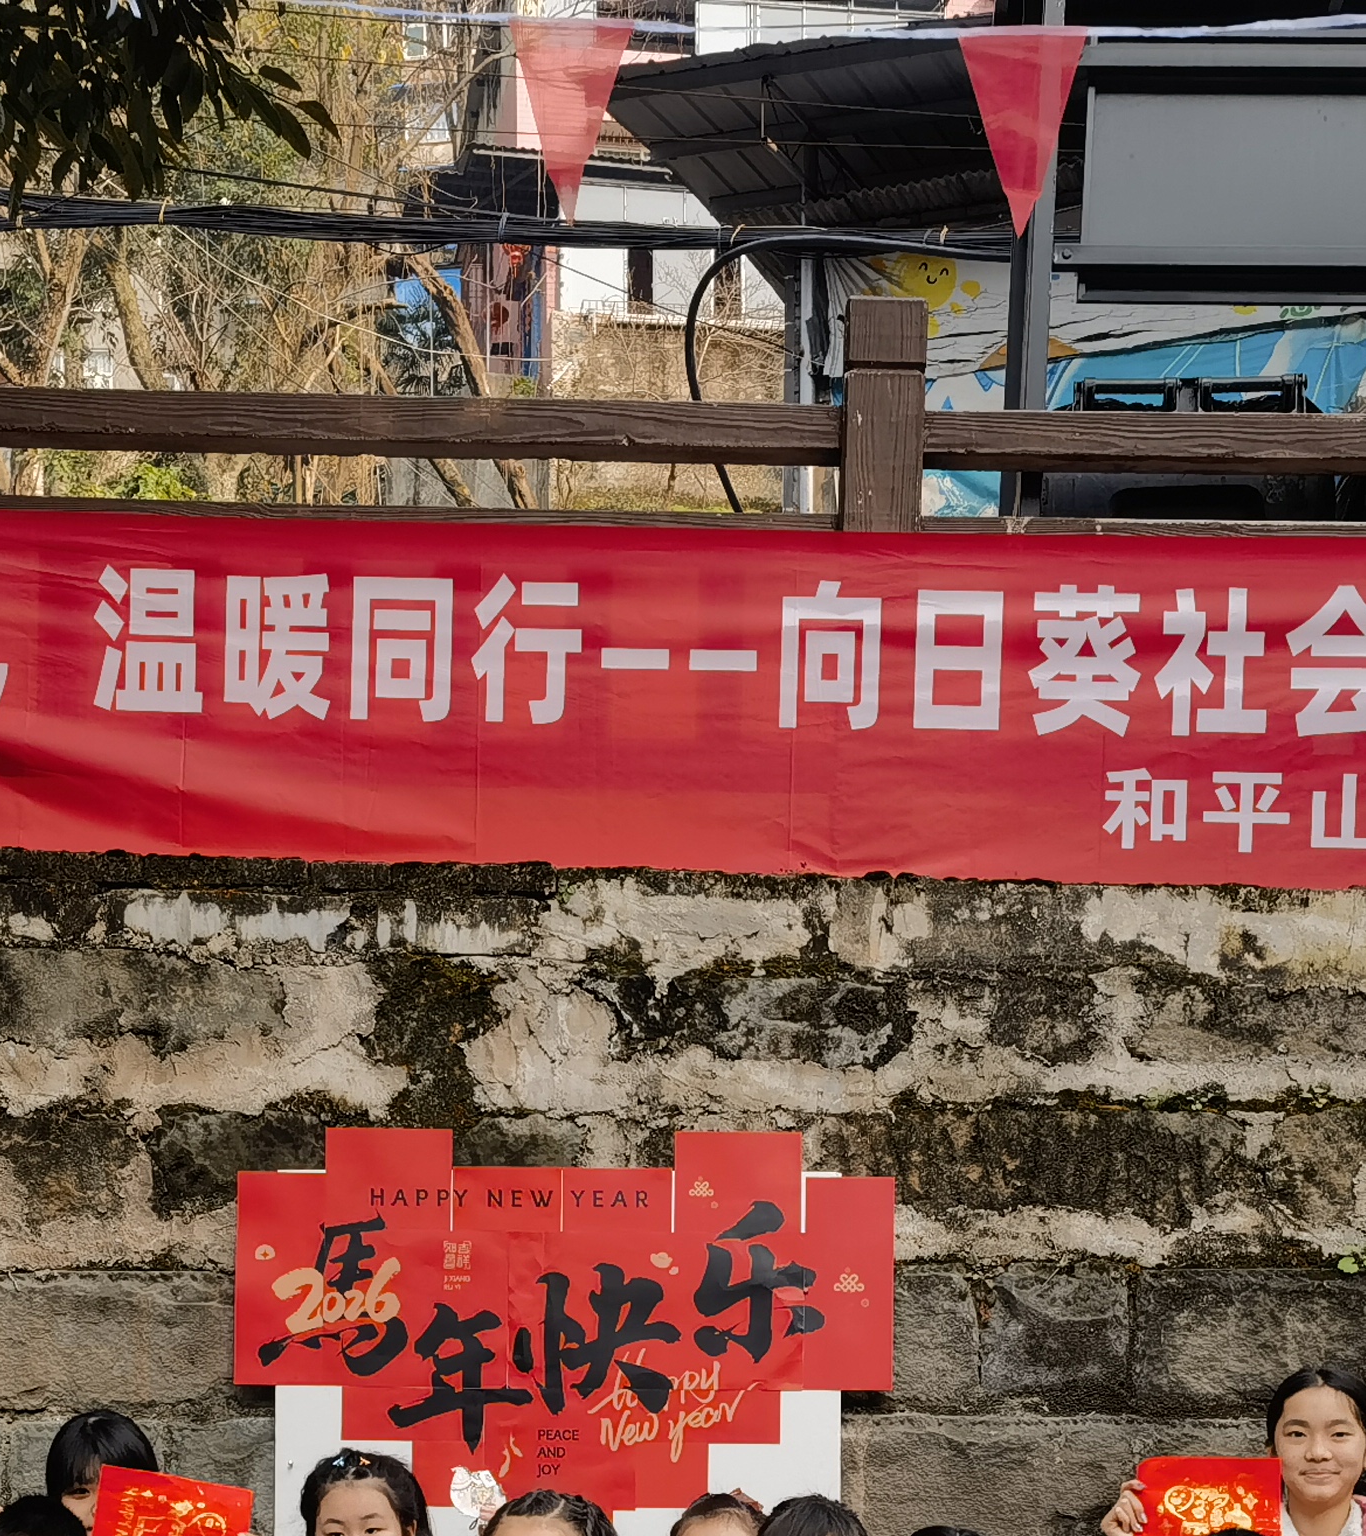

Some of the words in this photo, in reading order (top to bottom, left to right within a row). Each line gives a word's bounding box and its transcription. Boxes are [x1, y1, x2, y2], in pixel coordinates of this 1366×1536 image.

[370, 1187, 469, 1207] HAPPY
[487, 1188, 552, 1208] NEW
[570, 1190, 649, 1208] YEAR
[272, 1258, 402, 1334] 2026
[537, 1429, 580, 1442] PEACE
[537, 1447, 566, 1459] AND
[537, 1464, 561, 1477] JOY
